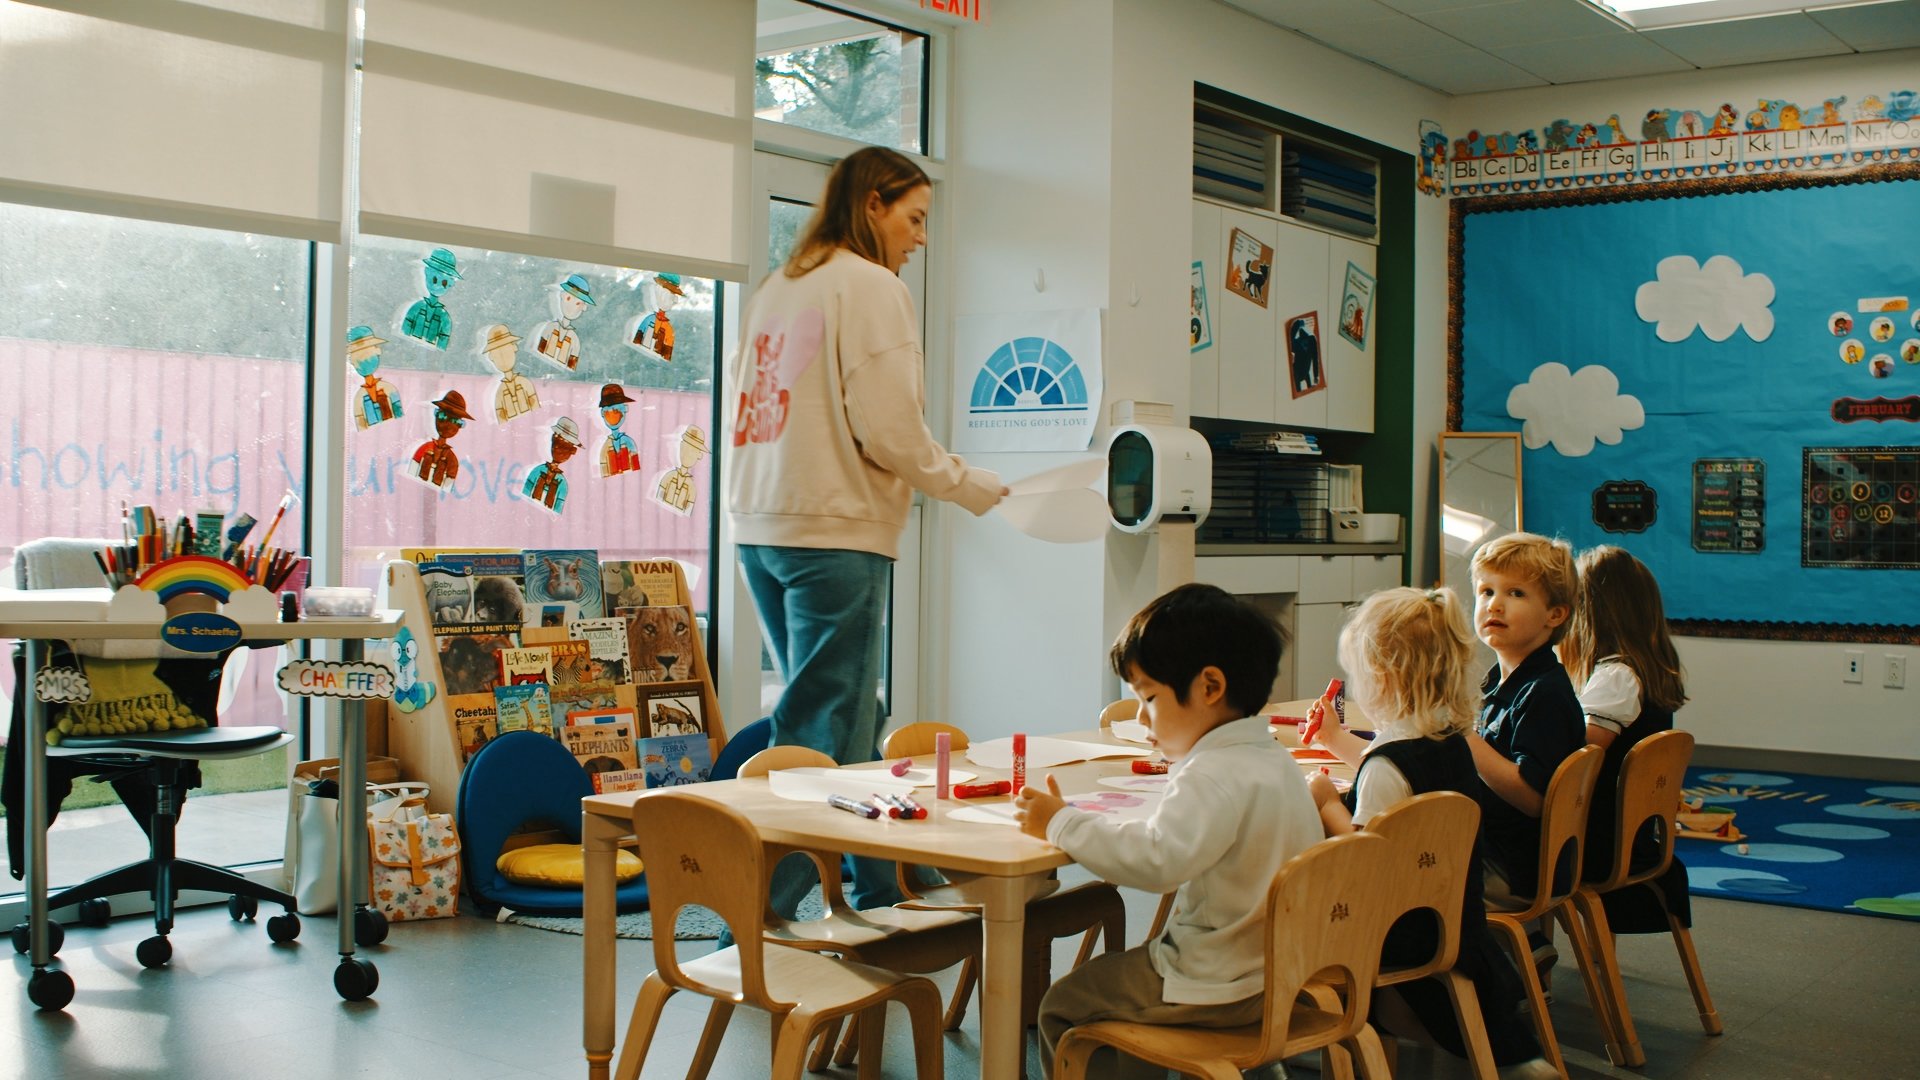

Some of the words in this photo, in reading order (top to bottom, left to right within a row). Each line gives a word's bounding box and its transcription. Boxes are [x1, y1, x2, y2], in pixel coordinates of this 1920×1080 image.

[1455, 161, 1477, 178] Bb
[1484, 159, 1506, 175] Cc
[1514, 155, 1537, 173] Dd
[1550, 152, 1570, 170] Ee
[1581, 149, 1600, 167] Ff
[1608, 147, 1634, 172] Gg
[1644, 144, 1669, 162] Hh
[1710, 138, 1733, 163] Jj
[1748, 134, 1772, 152] Kk
[1784, 131, 1800, 149] Ll
[1810, 128, 1845, 146] Mm
[1855, 124, 1882, 143] Nn
[1849, 404, 1912, 416] FEBRUARY
[968, 419, 1027, 428] REFLECTING
[1030, 418, 1060, 427] GOD'S
[1063, 417, 1088, 426] LOVE
[0, 415, 242, 518] howing
[1698, 463, 1724, 473] DAYS
[1732, 463, 1761, 473] WEEK
[634, 562, 673, 575] IVAN
[433, 580, 454, 590] Baby
[436, 588, 470, 598] Elephant
[167, 626, 188, 635] Mrs.
[191, 626, 240, 637] Schaeffer
[433, 626, 471, 635] ELEPHANTS
[579, 630, 618, 641] AMAZING
[551, 643, 587, 656] BRAS
[591, 647, 618, 656] EPTILES
[300, 668, 387, 691] CHAEFFER
[569, 738, 630, 757] ELEPHANTS
[660, 743, 689, 754] ZEBRAS
[602, 773, 622, 783] llama
[623, 771, 643, 780] llama
